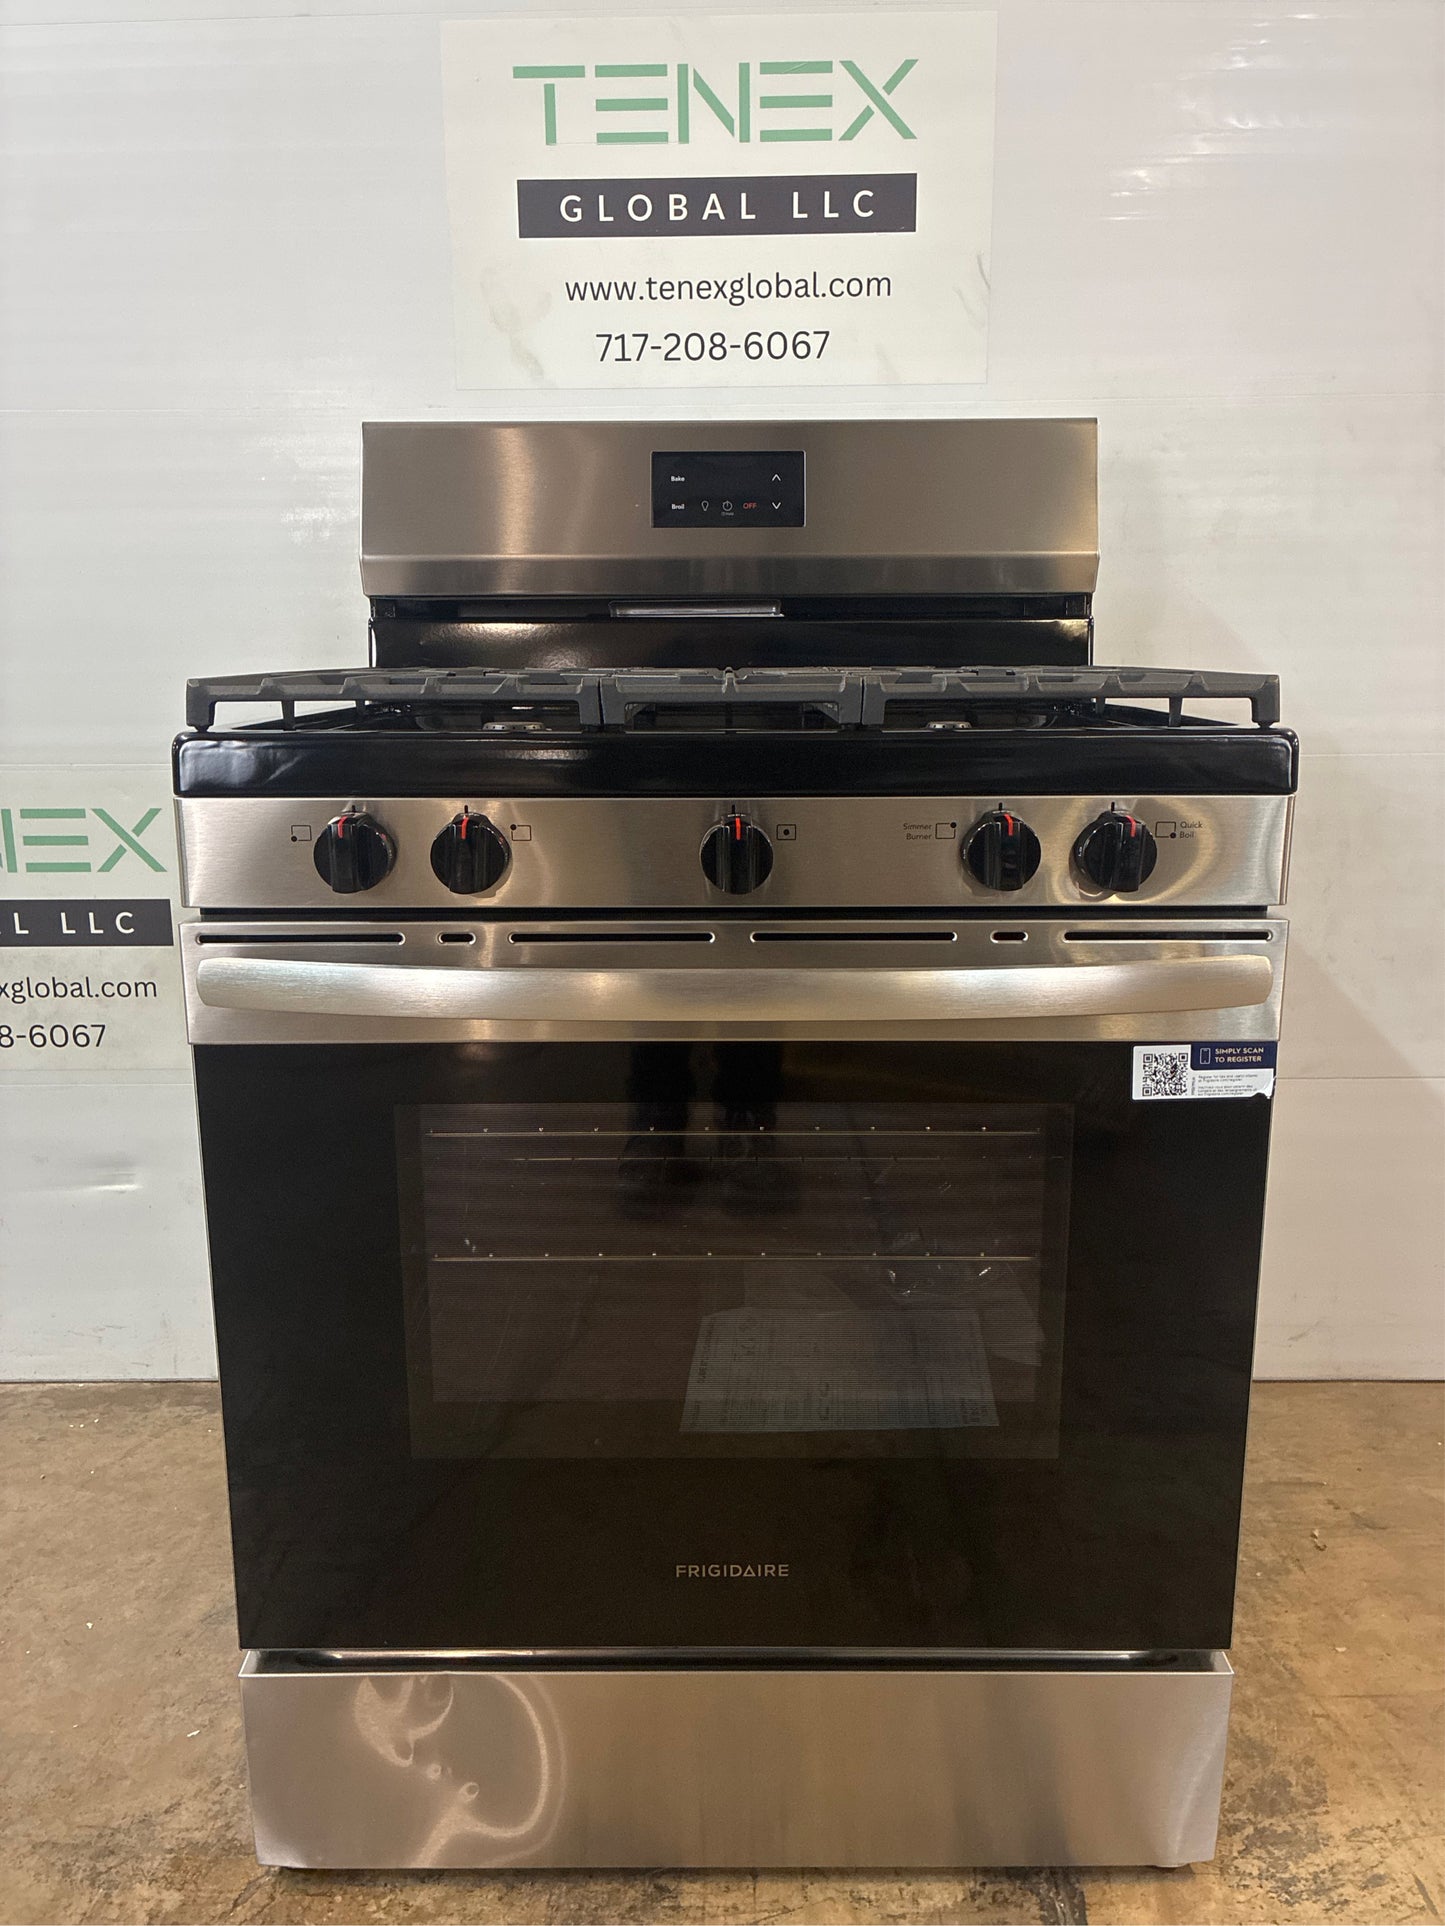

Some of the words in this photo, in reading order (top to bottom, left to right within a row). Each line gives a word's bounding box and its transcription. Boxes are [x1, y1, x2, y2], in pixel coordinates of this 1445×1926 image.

[512, 58, 919, 146] TENEX
[559, 192, 757, 223] GLOBAL
[792, 189, 876, 219] LLC
[565, 272, 892, 306] www.tenexglobal.com
[595, 330, 831, 363] 717-208-6067
[60, 911, 136, 934] LLC
[0, 1024, 106, 1048] 8-6067
[675, 1564, 790, 1578] FRIGIDAIRE
